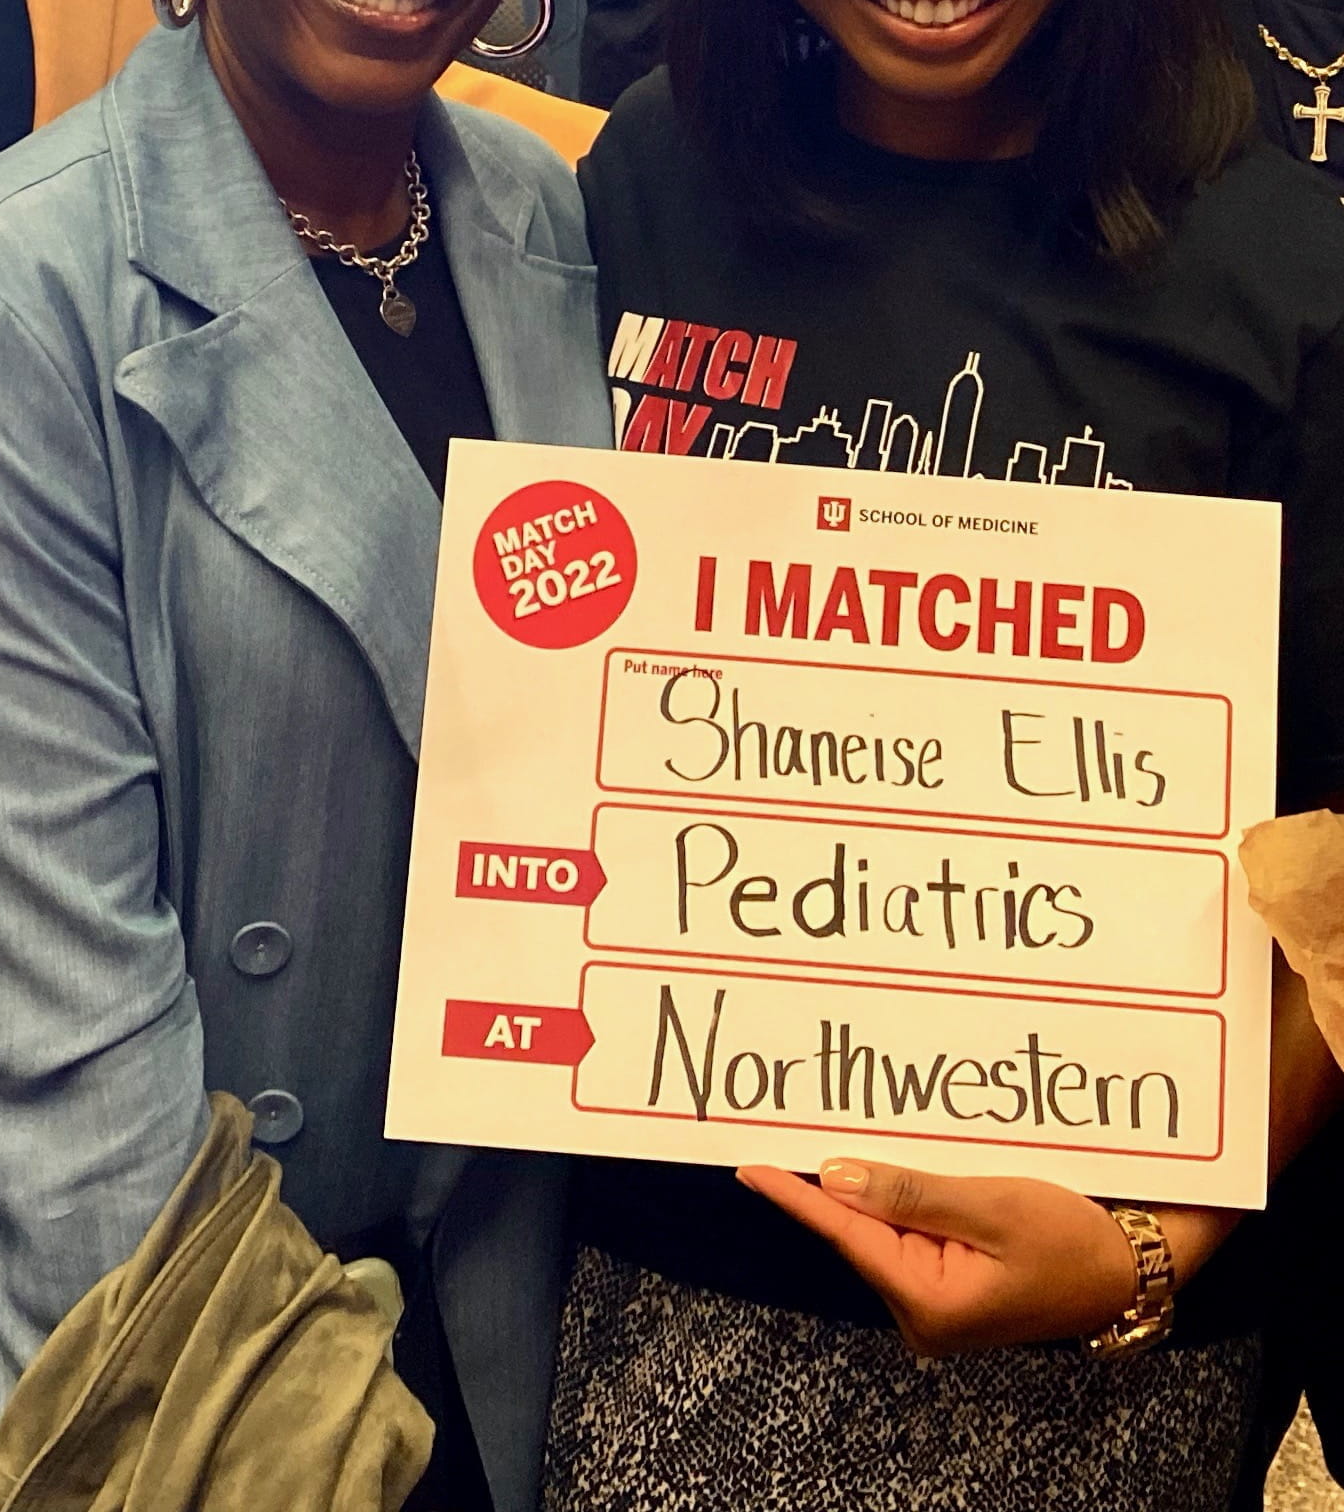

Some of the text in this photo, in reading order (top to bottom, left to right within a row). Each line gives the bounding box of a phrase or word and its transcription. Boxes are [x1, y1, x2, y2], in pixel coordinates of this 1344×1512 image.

[608, 311, 798, 411] MATCH
[493, 500, 598, 556] MATCH
[859, 509, 1039, 536] SCHOOL OF MEDICINE
[500, 540, 556, 581] DAY
[508, 550, 623, 619] 2022
[695, 556, 1146, 664] I MATCHED
[624, 659, 723, 680] Put name here
[660, 668, 1167, 806] Shaneise Ellis
[472, 853, 579, 893] INTO
[675, 822, 1094, 949] Pediatrics
[483, 1014, 542, 1050] AT
[648, 984, 1179, 1138] Northwestern
